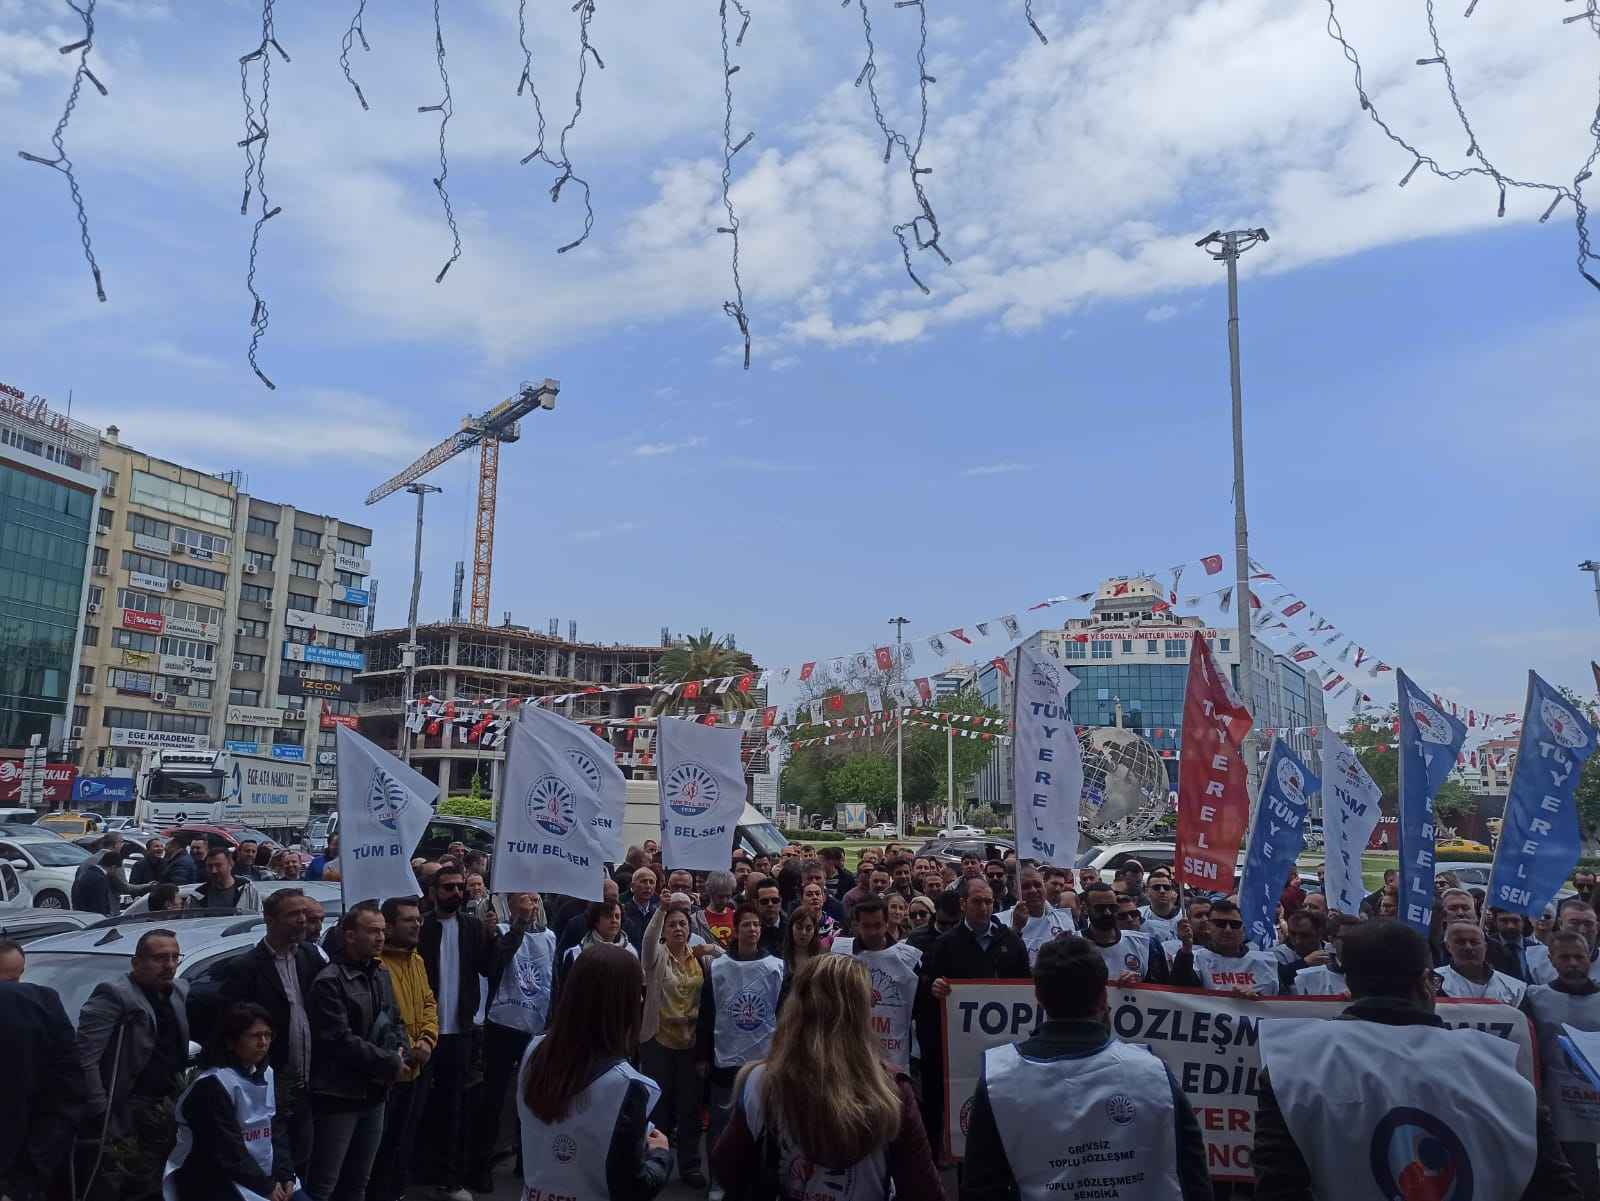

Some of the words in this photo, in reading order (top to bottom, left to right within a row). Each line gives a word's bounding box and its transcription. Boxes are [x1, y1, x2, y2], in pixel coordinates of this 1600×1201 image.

[1103, 632, 1127, 640] SOSYAL
[1030, 700, 1071, 722] TÜM
[127, 731, 146, 741] EGE
[147, 733, 196, 744] KARADENİZ
[1334, 784, 1368, 817] TÜM
[1267, 794, 1300, 829] TÜM
[674, 824, 725, 839] BEL-SEN
[353, 843, 384, 860] TÜM
[507, 838, 538, 854] TÜM
[1183, 855, 1218, 881] SEN
[1499, 884, 1532, 907] SEN
[1211, 971, 1257, 986] EMEK
[1048, 1157, 1081, 1169] TOPLU
[1082, 1150, 1136, 1165] SÖZLEŞME
[1074, 1189, 1120, 1201] SENDİKA
